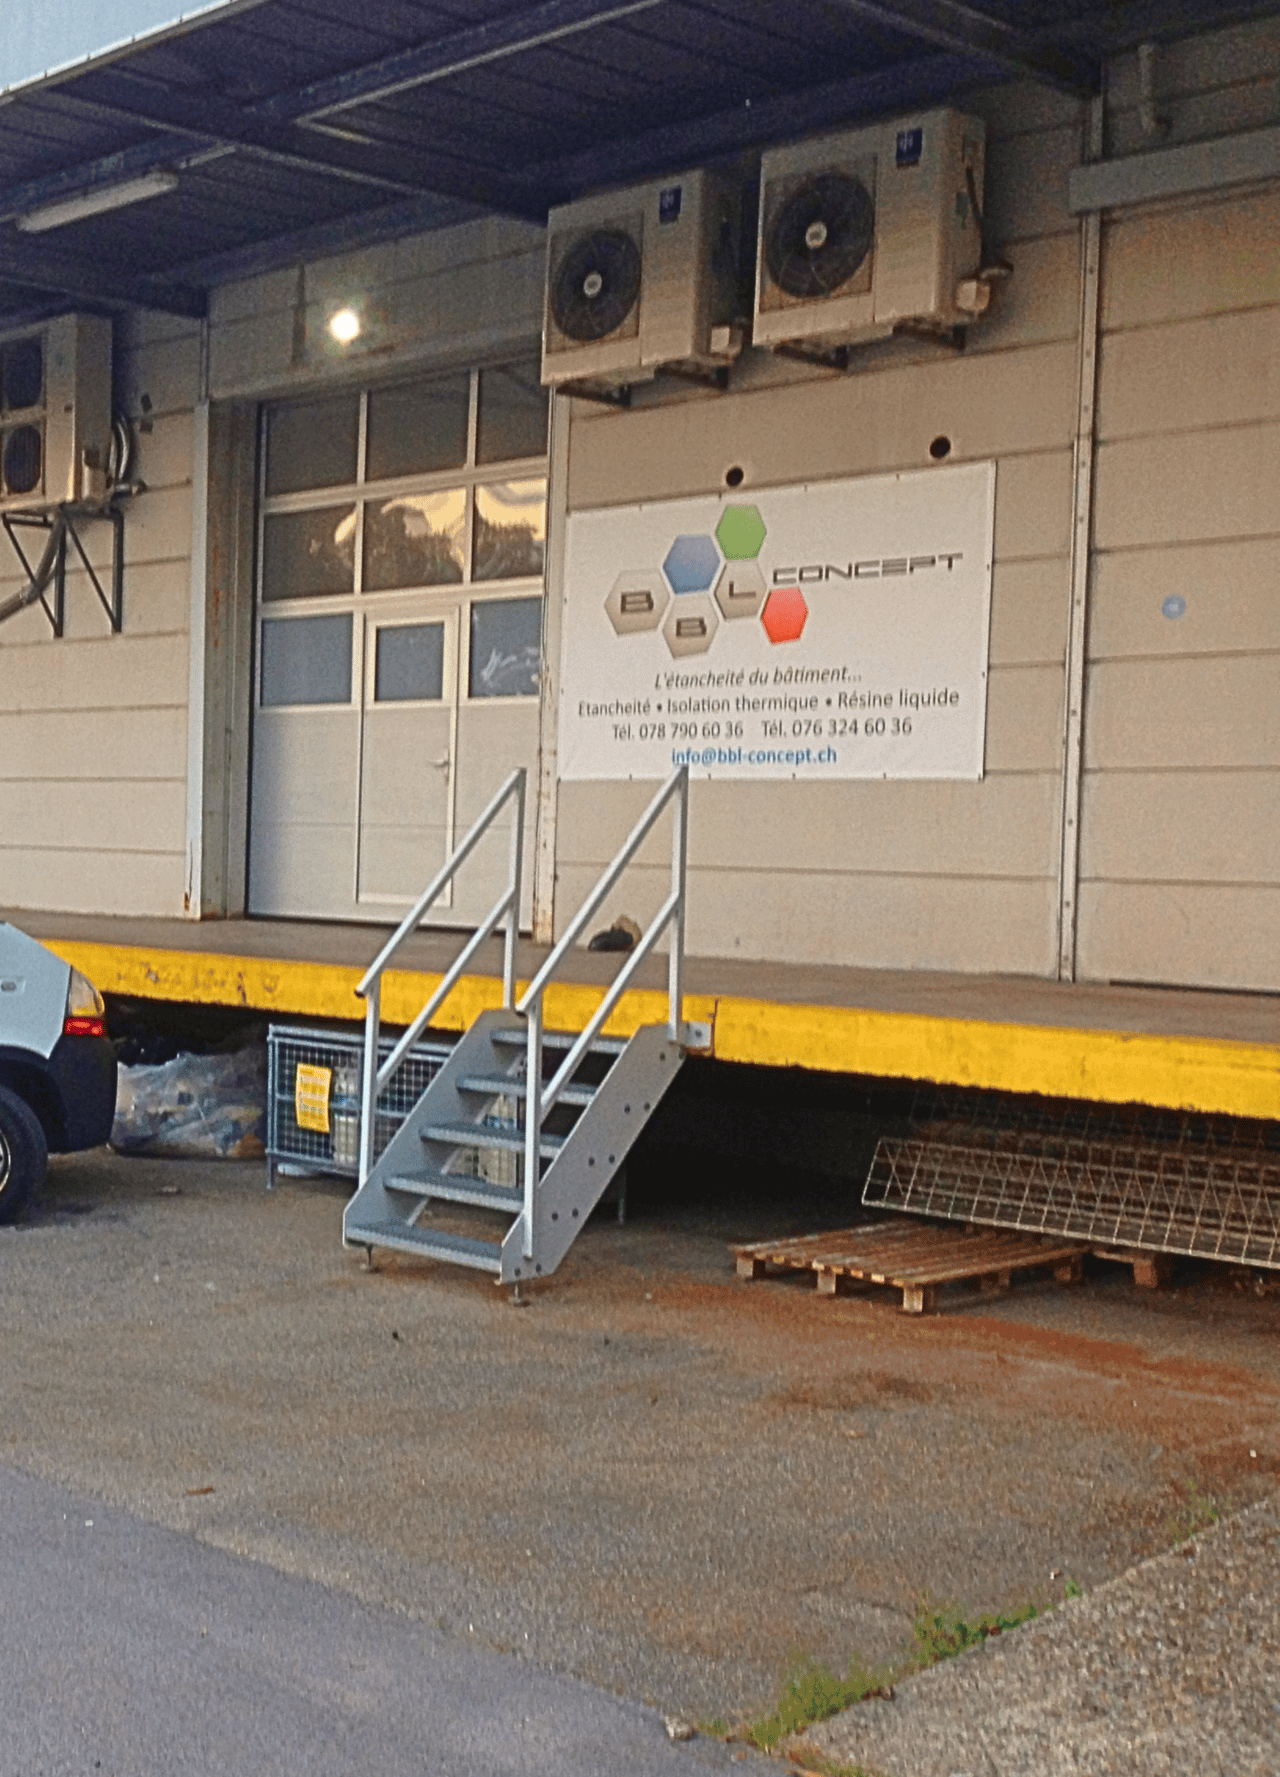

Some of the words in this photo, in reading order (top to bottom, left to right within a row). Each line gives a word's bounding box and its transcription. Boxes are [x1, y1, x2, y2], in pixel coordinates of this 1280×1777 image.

[772, 552, 964, 585] CONCEPT
[654, 671, 744, 690] L'étancheité
[749, 668, 769, 686] du
[773, 666, 862, 685] bâtiment...
[578, 698, 651, 717] Etancheité
[667, 695, 730, 714] Isolation
[735, 693, 818, 713] thermique
[838, 690, 893, 709] Résine
[899, 687, 960, 711] liquide
[612, 723, 635, 741] Tél.
[639, 723, 666, 740] 078
[671, 722, 698, 739] 790
[702, 721, 721, 739] 60
[725, 720, 744, 738] 36
[761, 719, 787, 738] Tél.
[792, 718, 823, 736] 076
[828, 717, 858, 736] 324
[864, 716, 886, 736] 60
[891, 715, 913, 735] 36
[671, 745, 838, 767] info@bbl-concept.ch
